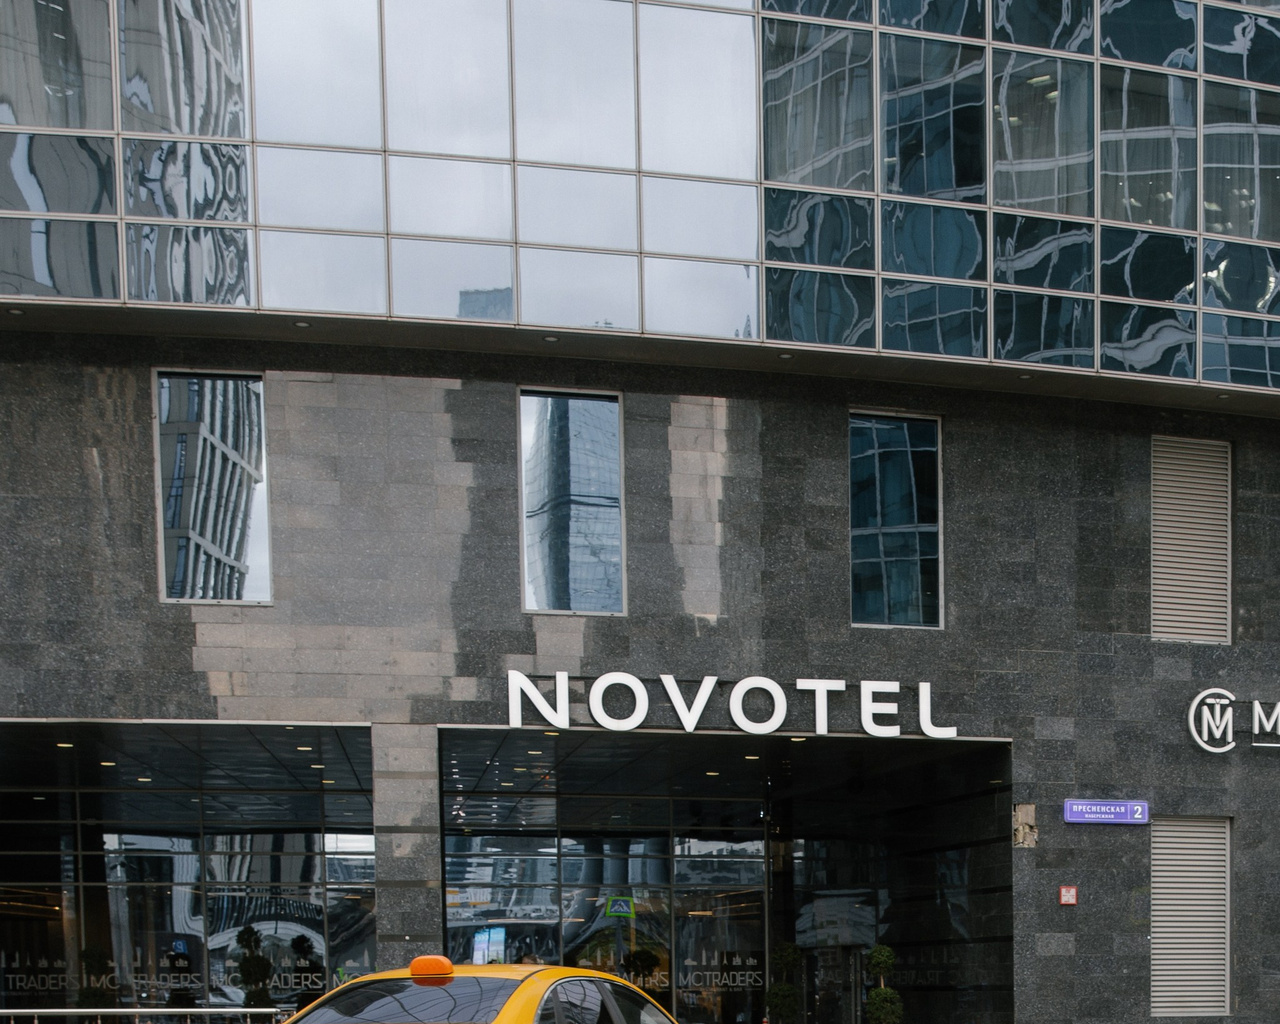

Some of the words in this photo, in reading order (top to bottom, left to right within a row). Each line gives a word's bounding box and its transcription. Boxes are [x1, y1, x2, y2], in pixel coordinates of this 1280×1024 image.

[507, 669, 957, 739] NOVOTEL
[1073, 805, 1125, 813] ПРЕСНЕНСКАЯ
[1134, 806, 1142, 818] 2
[5, 974, 80, 990] TRADERS
[267, 973, 322, 989] ADERS
